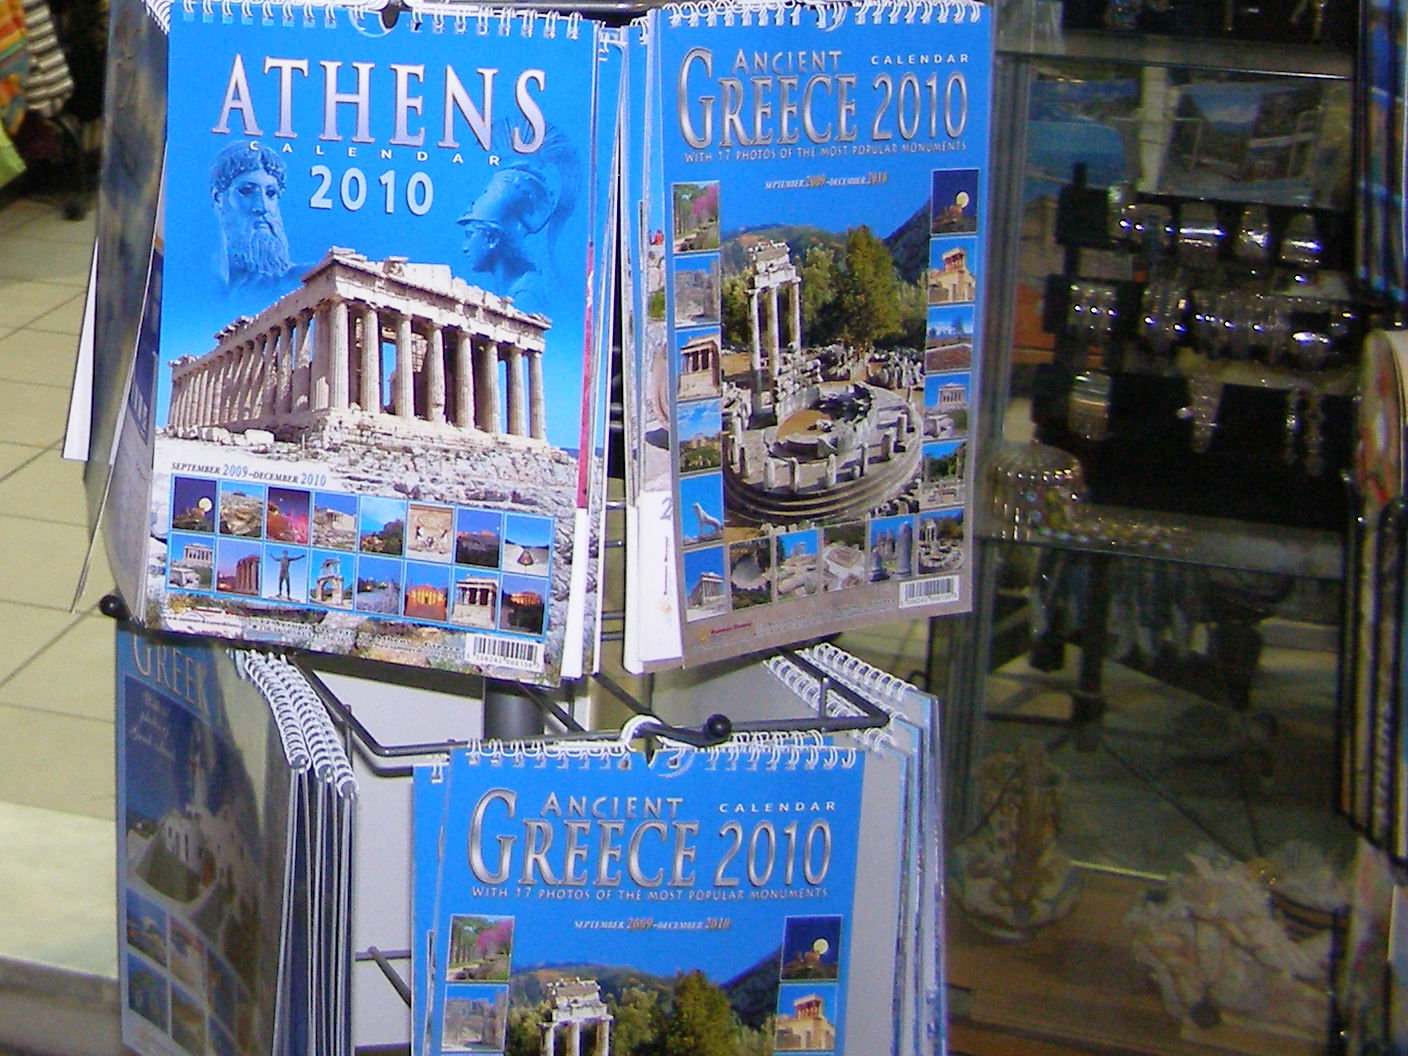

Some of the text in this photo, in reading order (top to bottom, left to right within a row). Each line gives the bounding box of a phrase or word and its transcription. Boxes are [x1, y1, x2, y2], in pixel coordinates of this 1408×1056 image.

[732, 49, 970, 76] ANCIENT CALENDAR
[211, 52, 548, 154] ATHENS
[677, 46, 968, 150] GREECE 2010
[249, 140, 501, 166] CALENDAR
[683, 140, 968, 164] WITH 17 PHOTOS OF THE MOST POPULAR MONUMENTS
[309, 165, 434, 216] 2010
[170, 462, 221, 474] SEPTEMBER
[301, 472, 327, 488] 2010
[540, 791, 836, 820] ANCIENT CALENDAR
[467, 787, 832, 888] GREECE 2010
[471, 885, 829, 901] WITH 17 PHOTOS OF THE MOST POPULAR MONUMENTS
[574, 920, 625, 929] SEPTEMBER
